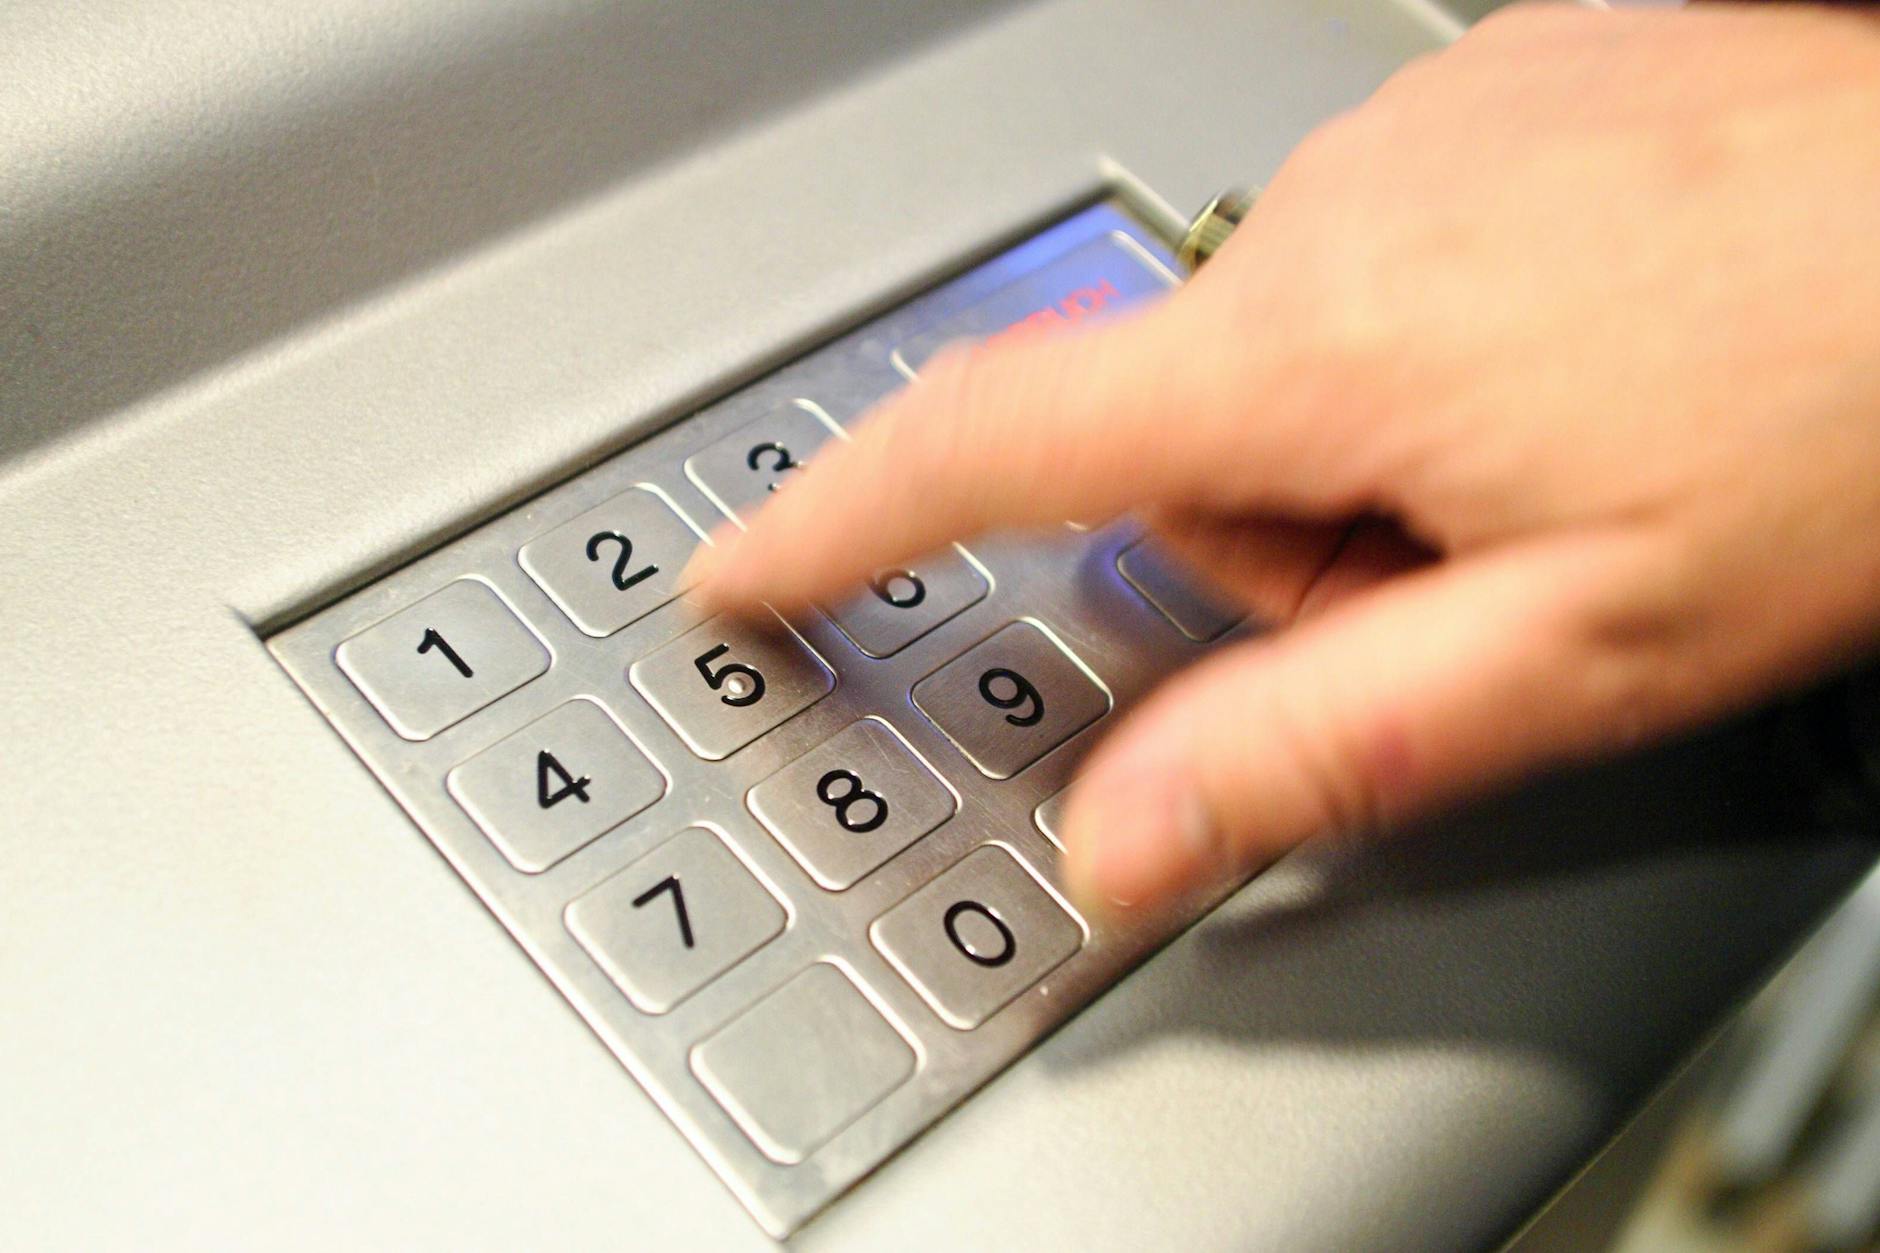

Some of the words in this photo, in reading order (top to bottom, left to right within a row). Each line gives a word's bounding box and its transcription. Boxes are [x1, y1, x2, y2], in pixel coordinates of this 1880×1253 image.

[746, 441, 806, 493] 3
[586, 530, 660, 591] 2
[416, 626, 474, 679] 1
[693, 642, 766, 708] 5
[978, 667, 1046, 728] 9
[537, 749, 591, 810] 4
[815, 768, 889, 834] 8
[632, 874, 695, 949] 7
[943, 900, 1016, 968] 0
